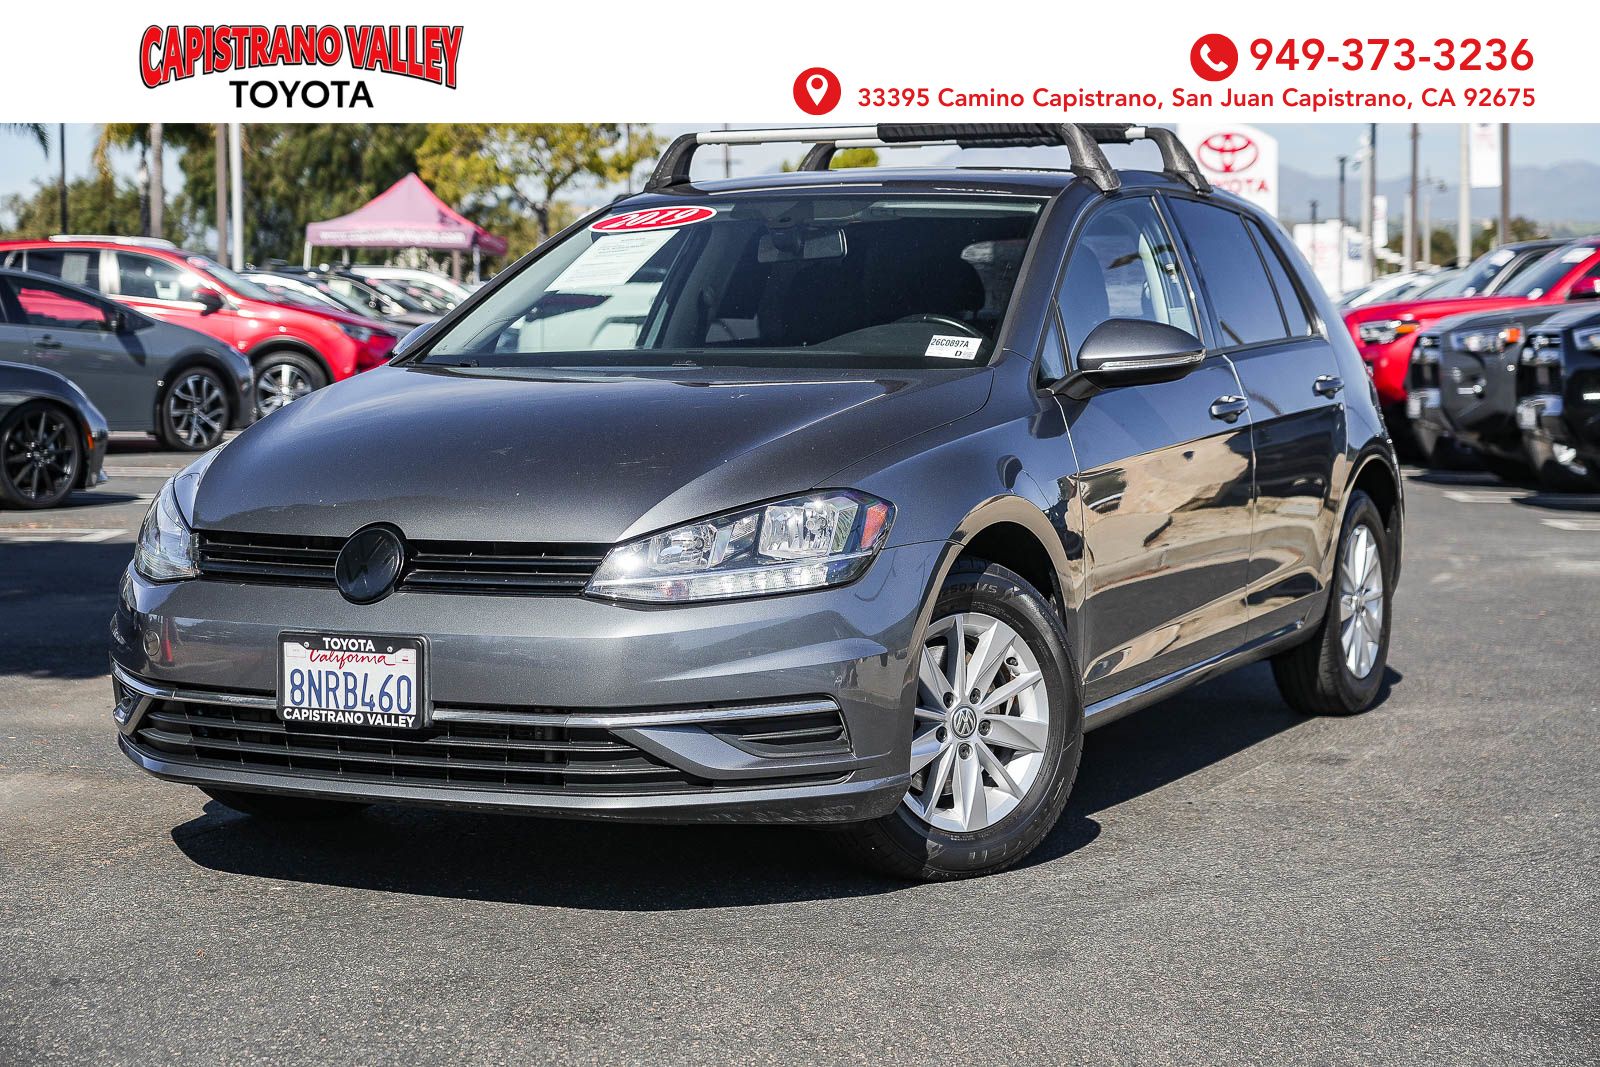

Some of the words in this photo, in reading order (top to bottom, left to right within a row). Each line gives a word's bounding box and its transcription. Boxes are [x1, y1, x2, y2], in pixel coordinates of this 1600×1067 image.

[602, 208, 701, 229] 2019
[930, 338, 969, 348] 26C0897A
[322, 637, 376, 652] TOYOTA
[309, 649, 396, 669] California
[289, 668, 412, 714] 8NRB460
[283, 708, 364, 724] CAPISTRANO
[366, 713, 415, 728] VALLEY
